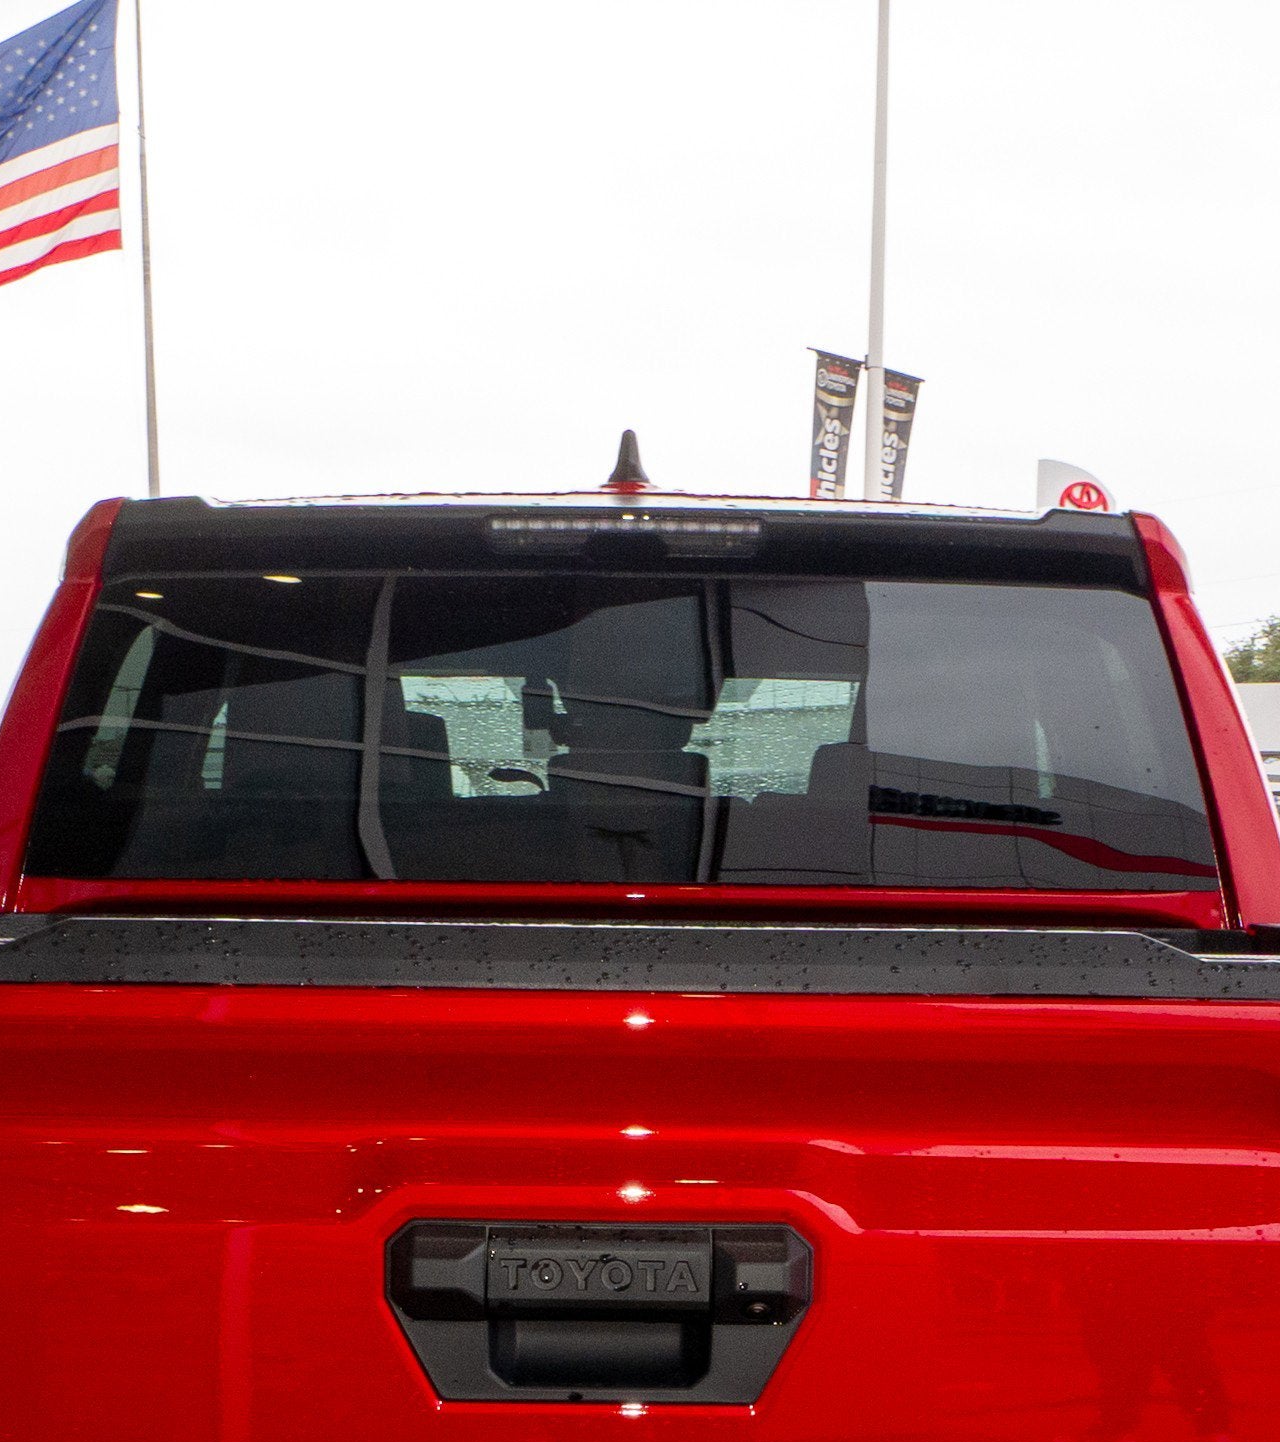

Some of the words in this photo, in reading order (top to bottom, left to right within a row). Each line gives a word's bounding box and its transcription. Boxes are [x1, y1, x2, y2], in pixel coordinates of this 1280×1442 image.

[816, 417, 842, 499] hicles
[880, 431, 899, 495] icles
[500, 1258, 700, 1293] TOYOTA
